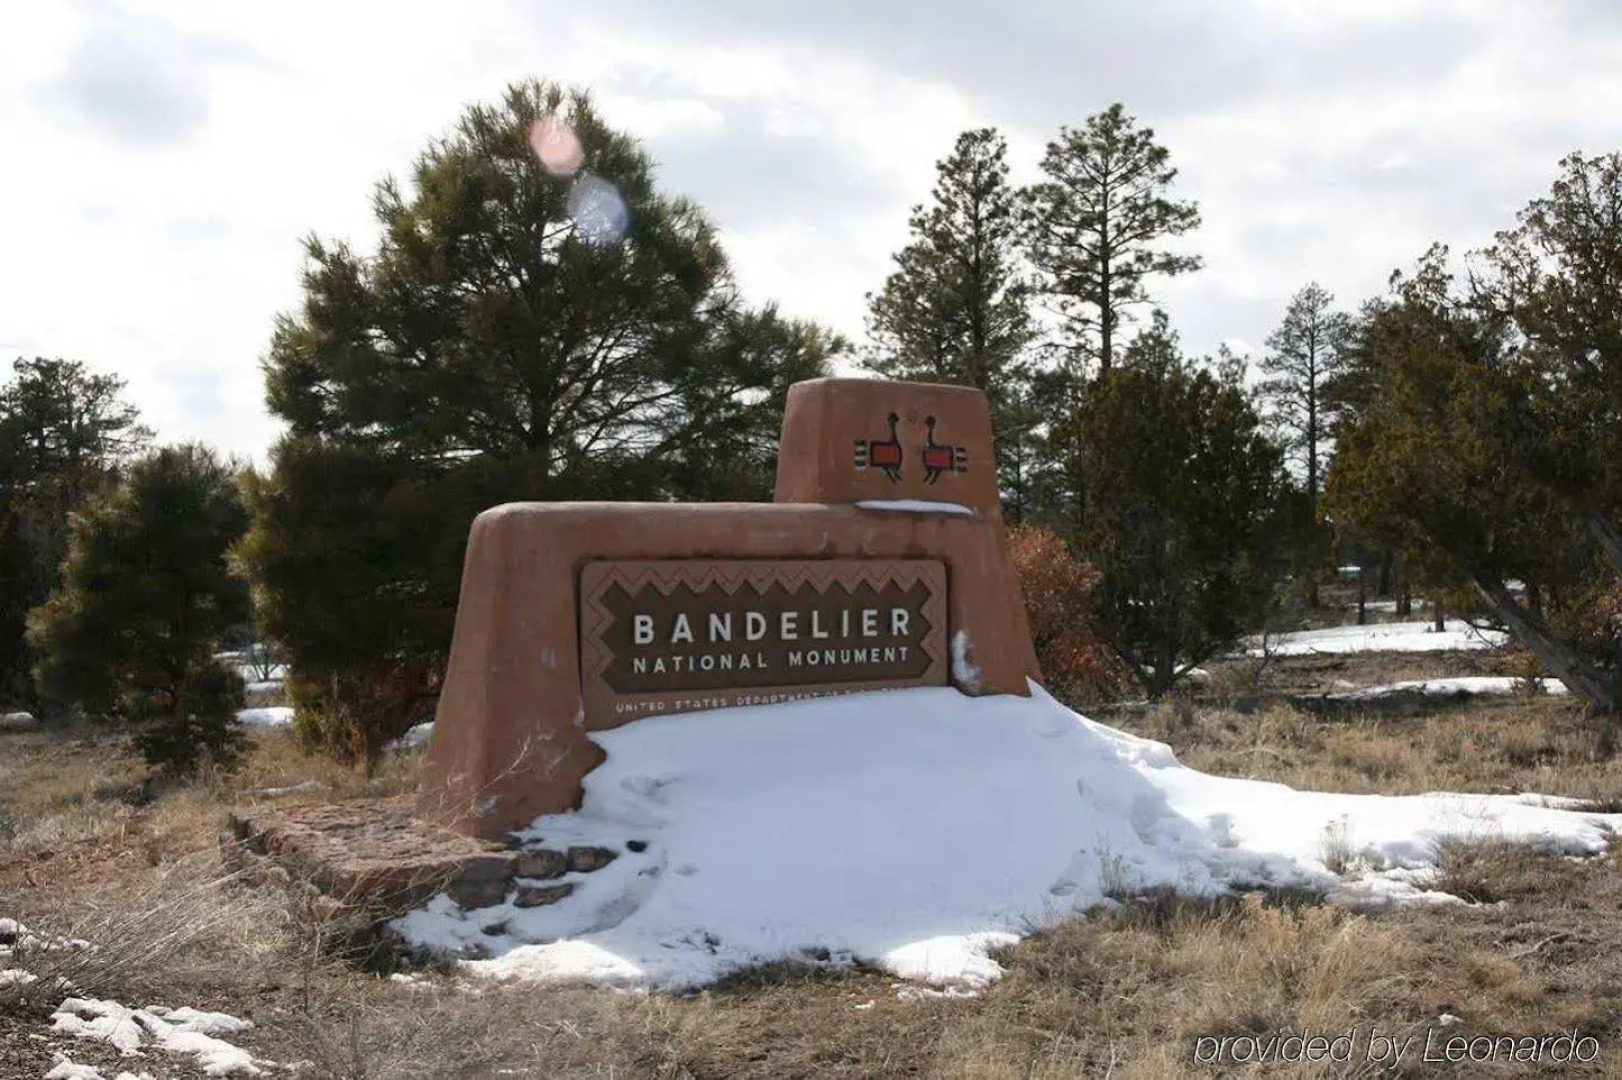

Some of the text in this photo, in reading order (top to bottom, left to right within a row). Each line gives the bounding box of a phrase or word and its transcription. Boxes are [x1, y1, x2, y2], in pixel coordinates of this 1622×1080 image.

[633, 608, 909, 645] BANDELIER
[633, 646, 908, 674] NATIONAL MONUMENT
[616, 701, 665, 713] UNITED
[675, 699, 728, 709] STATES
